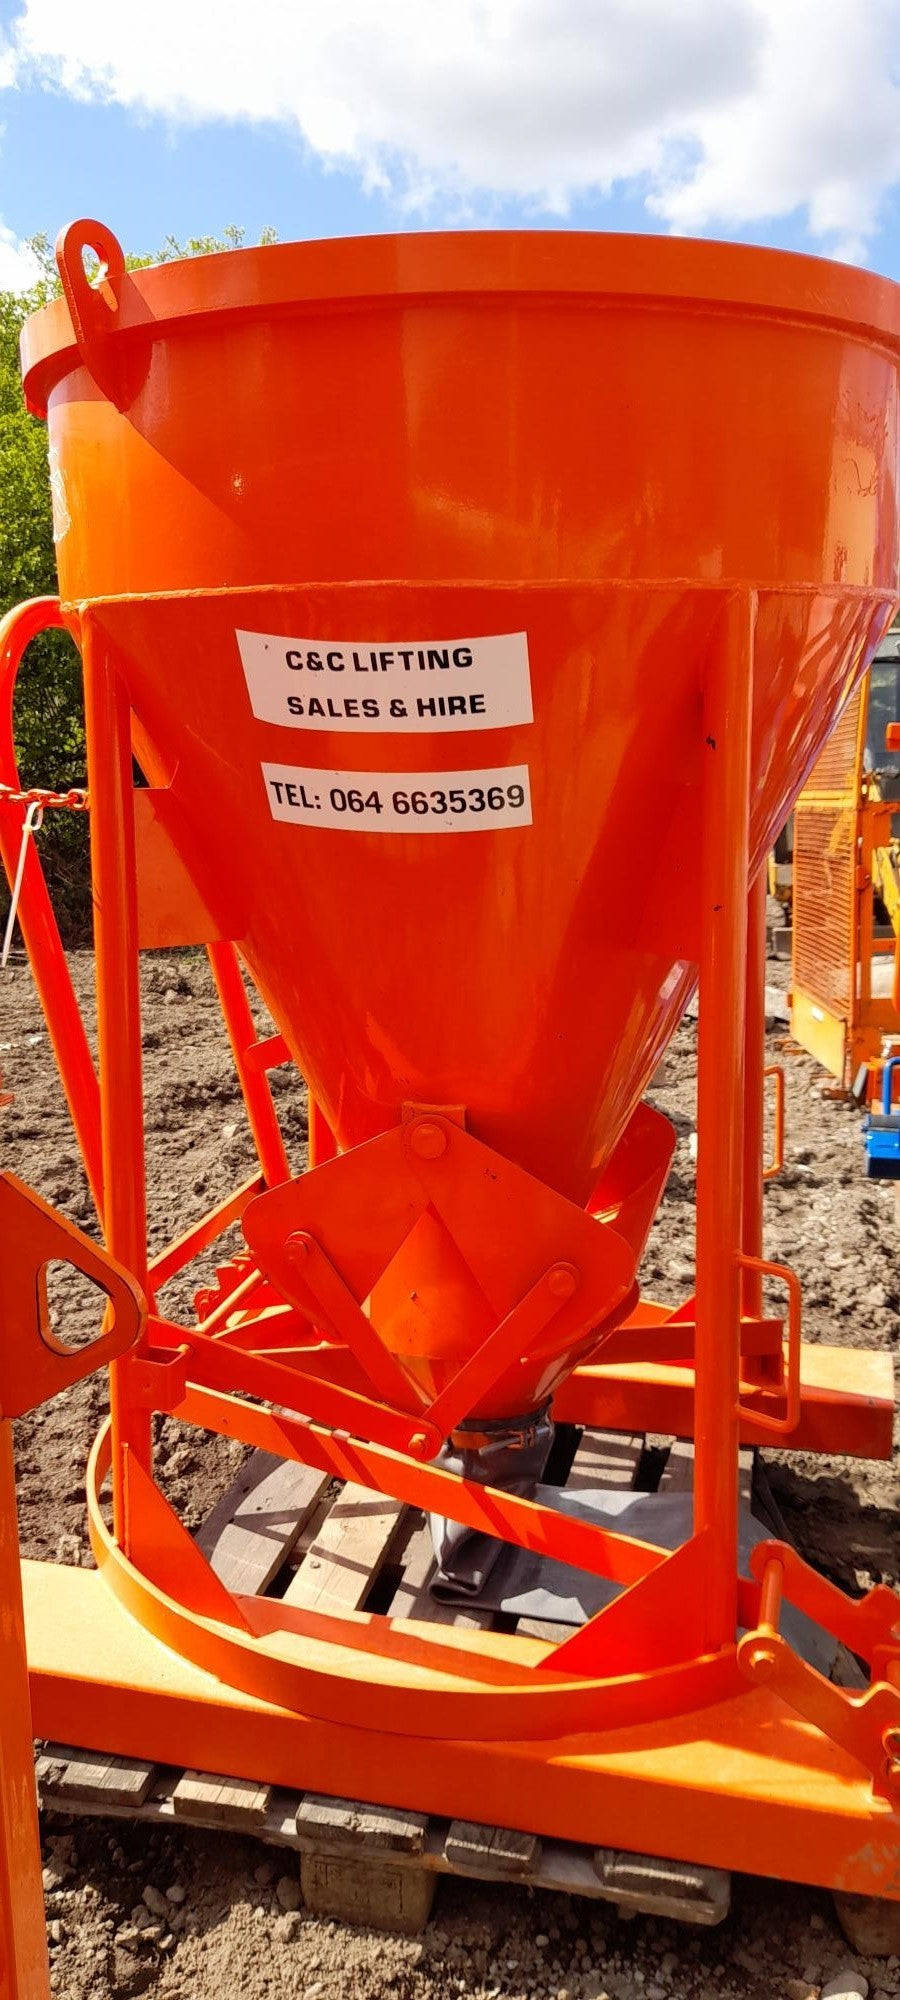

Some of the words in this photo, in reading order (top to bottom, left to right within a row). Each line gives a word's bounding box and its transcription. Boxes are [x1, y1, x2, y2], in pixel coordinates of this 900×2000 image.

[285, 650, 345, 672] C&C
[352, 647, 473, 672] LIFTING
[286, 696, 380, 718] SALES
[389, 698, 408, 718] &
[416, 693, 486, 718] HIRE
[269, 780, 322, 810] TEL:
[329, 787, 384, 815] 064
[391, 784, 525, 815] 6635369
